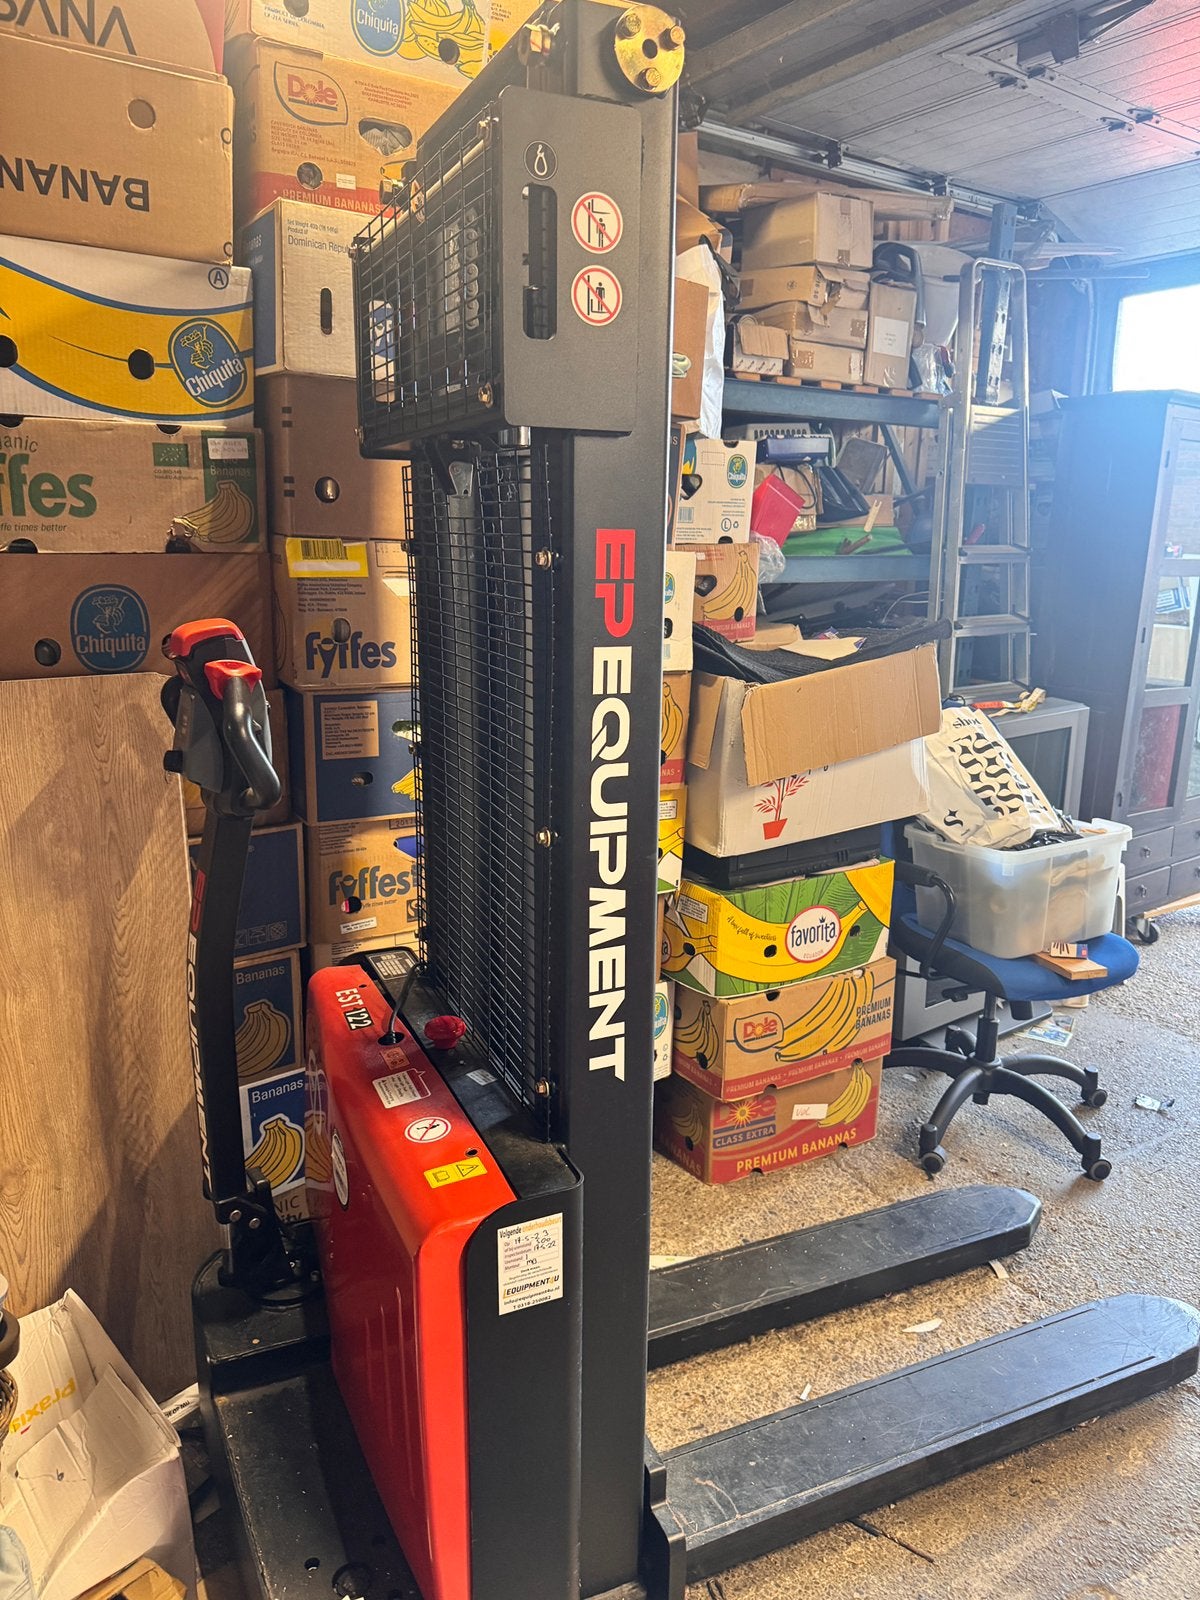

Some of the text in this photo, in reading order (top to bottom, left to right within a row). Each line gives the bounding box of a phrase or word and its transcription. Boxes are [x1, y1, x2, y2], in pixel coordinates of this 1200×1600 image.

[356, 10, 399, 36] Chiquita
[287, 73, 339, 106] Dole
[282, 189, 382, 214] PREMIUM BANANAS
[287, 235, 327, 250] Dominican
[185, 356, 244, 398] Chiquita
[0, 434, 38, 453] anic
[210, 464, 250, 476] Bananas
[14, 523, 38, 532] times
[41, 523, 66, 532] better
[76, 634, 147, 658] Chiquita
[305, 631, 397, 678] fyffes
[589, 528, 636, 1081] EP EQUIPMENT
[329, 865, 411, 905] fyffes
[791, 921, 836, 948] favorita
[236, 965, 285, 984] Bananas
[335, 988, 364, 1008] EST
[856, 996, 891, 1016] PREMIUM
[346, 1008, 372, 1029] 122
[743, 1017, 778, 1039] Dole
[855, 1008, 891, 1030] BANANAS
[726, 1081, 755, 1093] PREMIUM
[755, 1074, 781, 1086] BANANAS
[788, 1064, 814, 1077] PREMIUM
[814, 1056, 839, 1070] BANANAS
[252, 1078, 304, 1103] Bananas
[715, 1126, 775, 1147] CLASS EXTRA
[736, 1128, 857, 1173] PREMIUM BANANAS
[500, 1226, 522, 1239] Volgende
